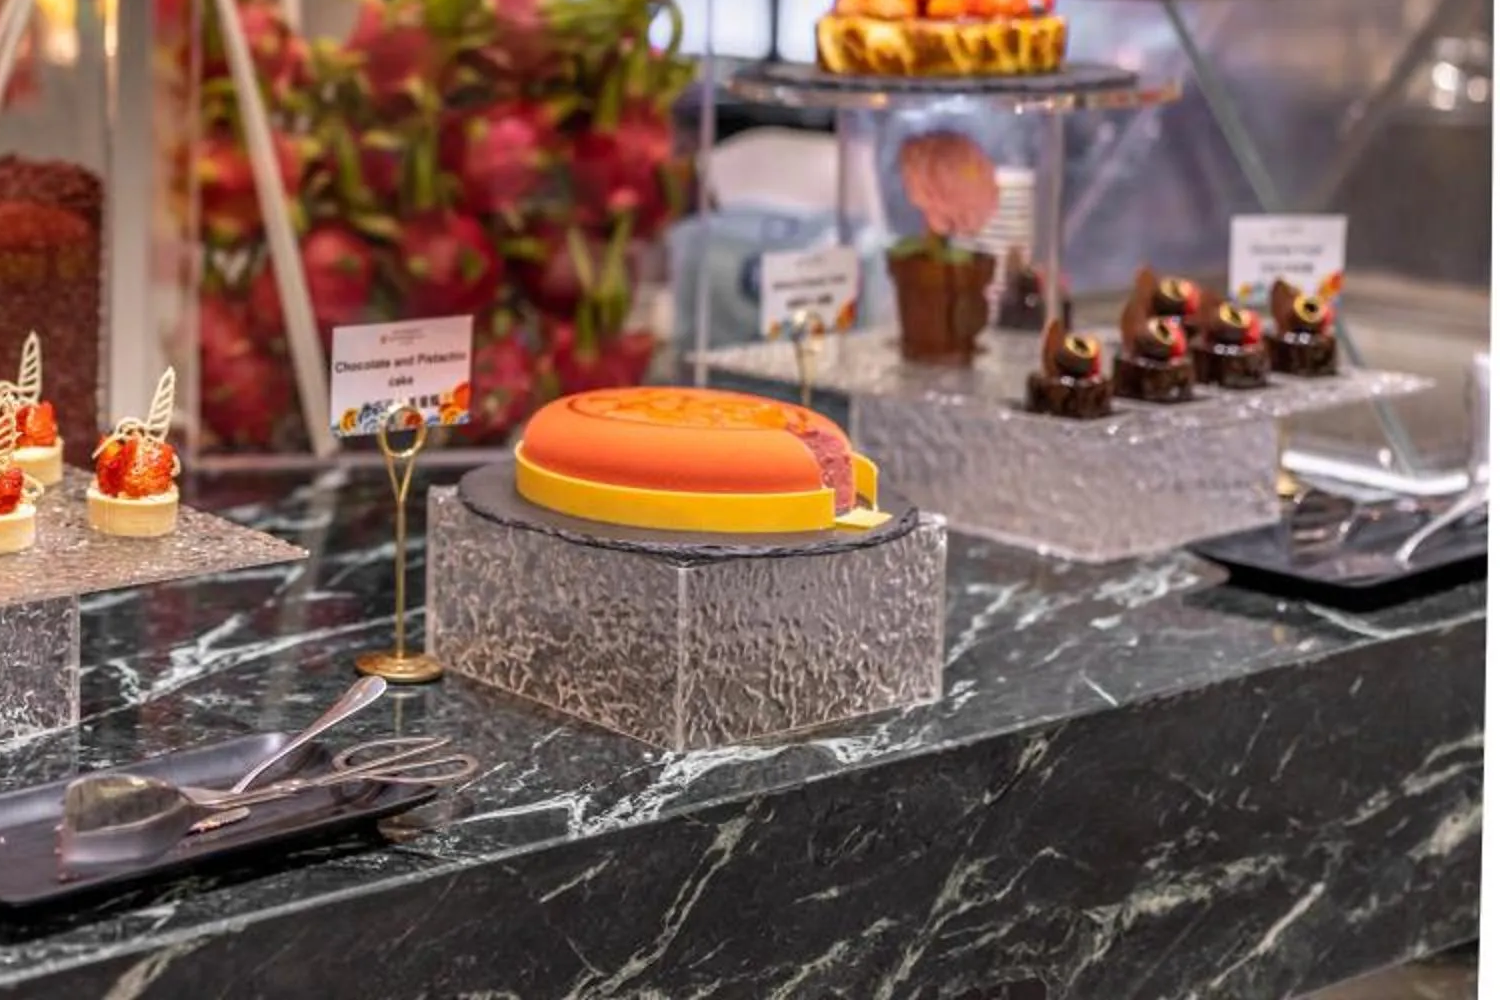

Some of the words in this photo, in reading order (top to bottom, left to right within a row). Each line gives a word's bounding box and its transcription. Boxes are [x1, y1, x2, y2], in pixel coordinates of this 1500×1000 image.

[335, 359, 391, 374] Chocolate
[394, 355, 415, 368] and
[388, 375, 414, 387] cake
